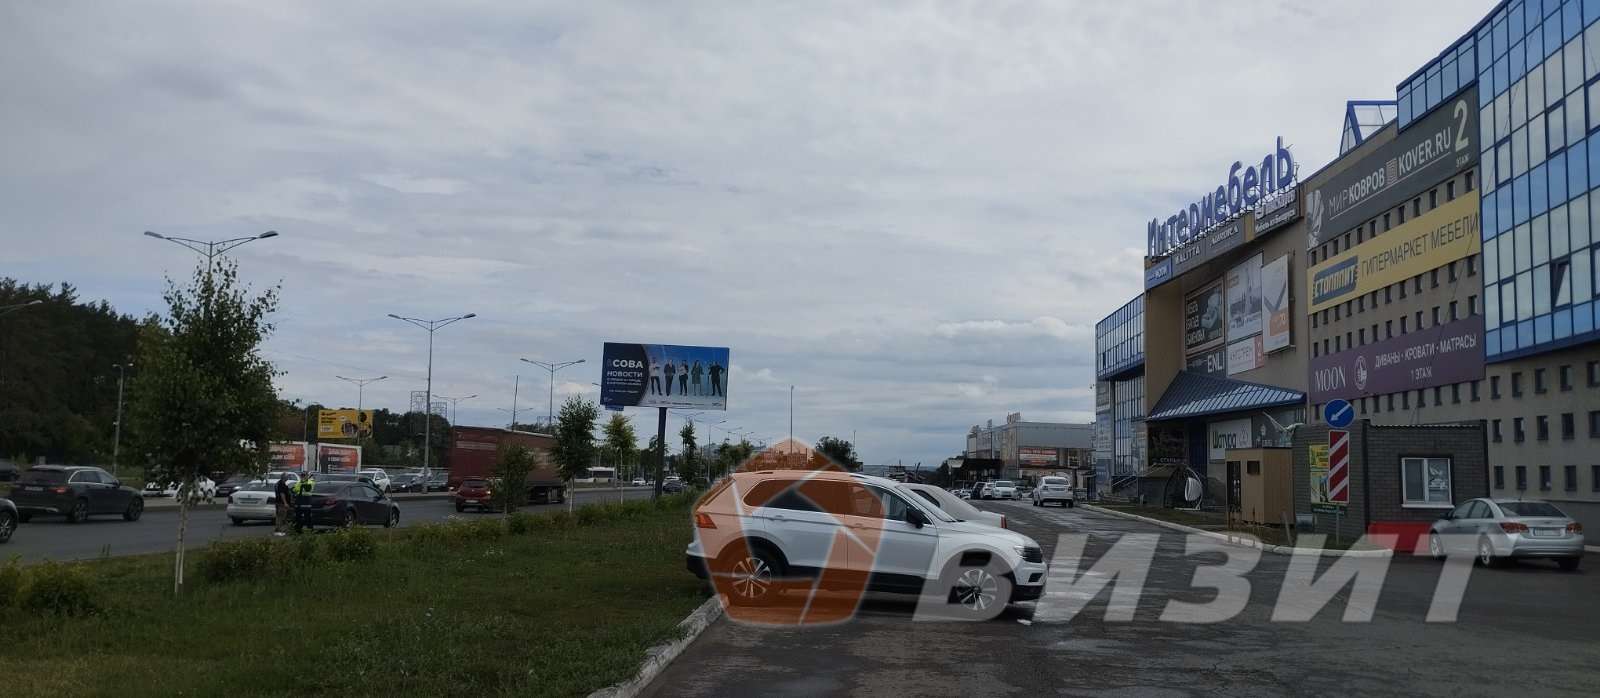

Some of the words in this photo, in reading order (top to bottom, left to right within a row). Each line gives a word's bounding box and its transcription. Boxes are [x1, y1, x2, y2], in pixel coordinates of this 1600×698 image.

[1454, 100, 1469, 151] 2
[1399, 128, 1451, 176] KOVER.RU
[1148, 136, 1293, 257] Интермебель
[1361, 235, 1428, 280] ГИПЕРМАРКЕТ
[1431, 213, 1479, 249] МЕБЕЛИ
[612, 359, 644, 369] СОВА
[1375, 351, 1400, 369] ДИВАНЫ
[1405, 344, 1435, 361] КРОВАТИ
[1440, 334, 1477, 352] МАТРАСЫ
[1315, 367, 1346, 392] MOON
